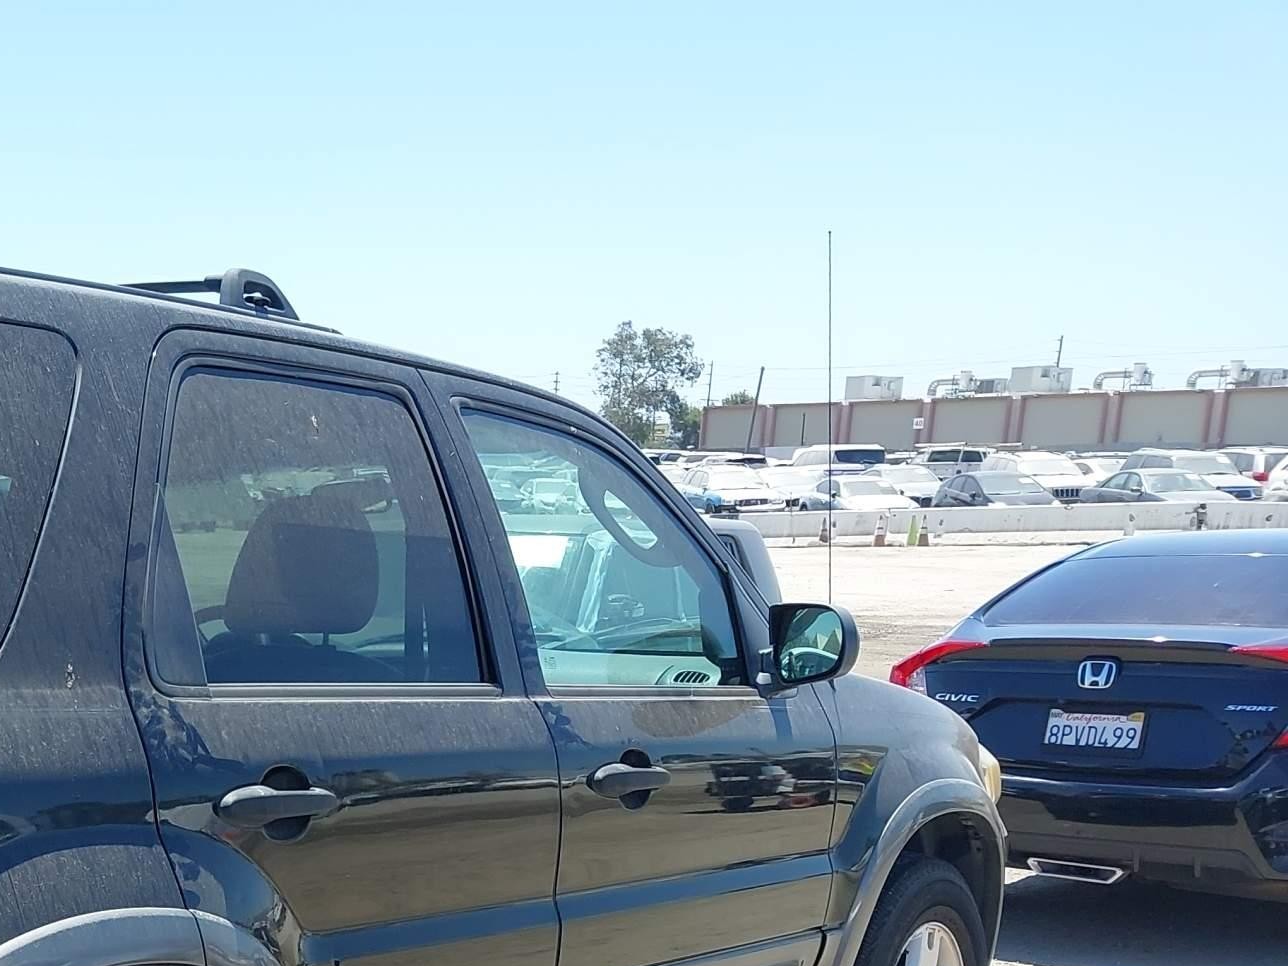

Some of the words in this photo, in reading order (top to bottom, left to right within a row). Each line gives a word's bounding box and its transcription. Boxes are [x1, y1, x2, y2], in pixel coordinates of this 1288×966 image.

[935, 692, 980, 702] CIVIC
[1224, 704, 1280, 712] SPORT
[1048, 724, 1138, 749] 8PVD499
